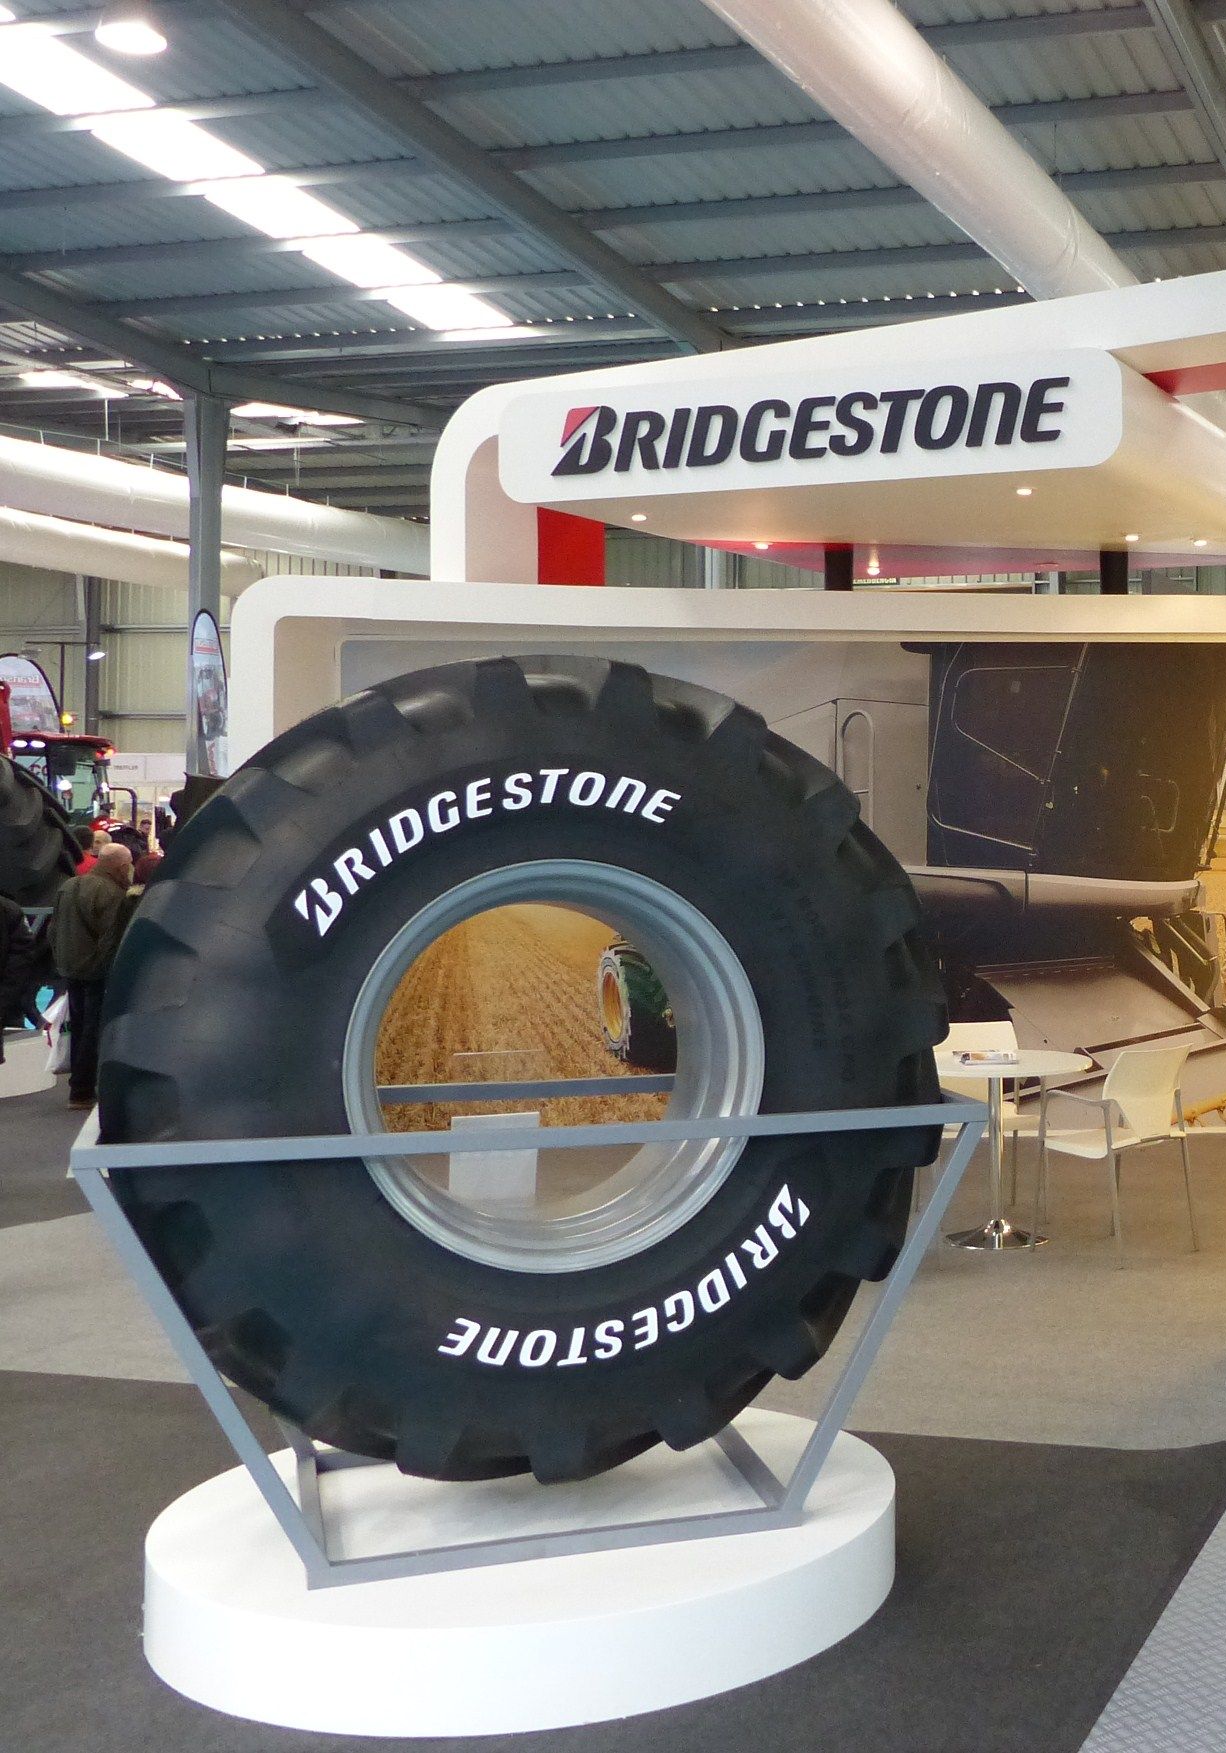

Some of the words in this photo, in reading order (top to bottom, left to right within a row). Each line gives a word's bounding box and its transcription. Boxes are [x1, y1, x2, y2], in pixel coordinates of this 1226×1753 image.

[550, 376, 1070, 477] BRIDGESTONE
[294, 768, 681, 937] BRIDGESTONE
[437, 1183, 811, 1368] BRIDGESTONE
